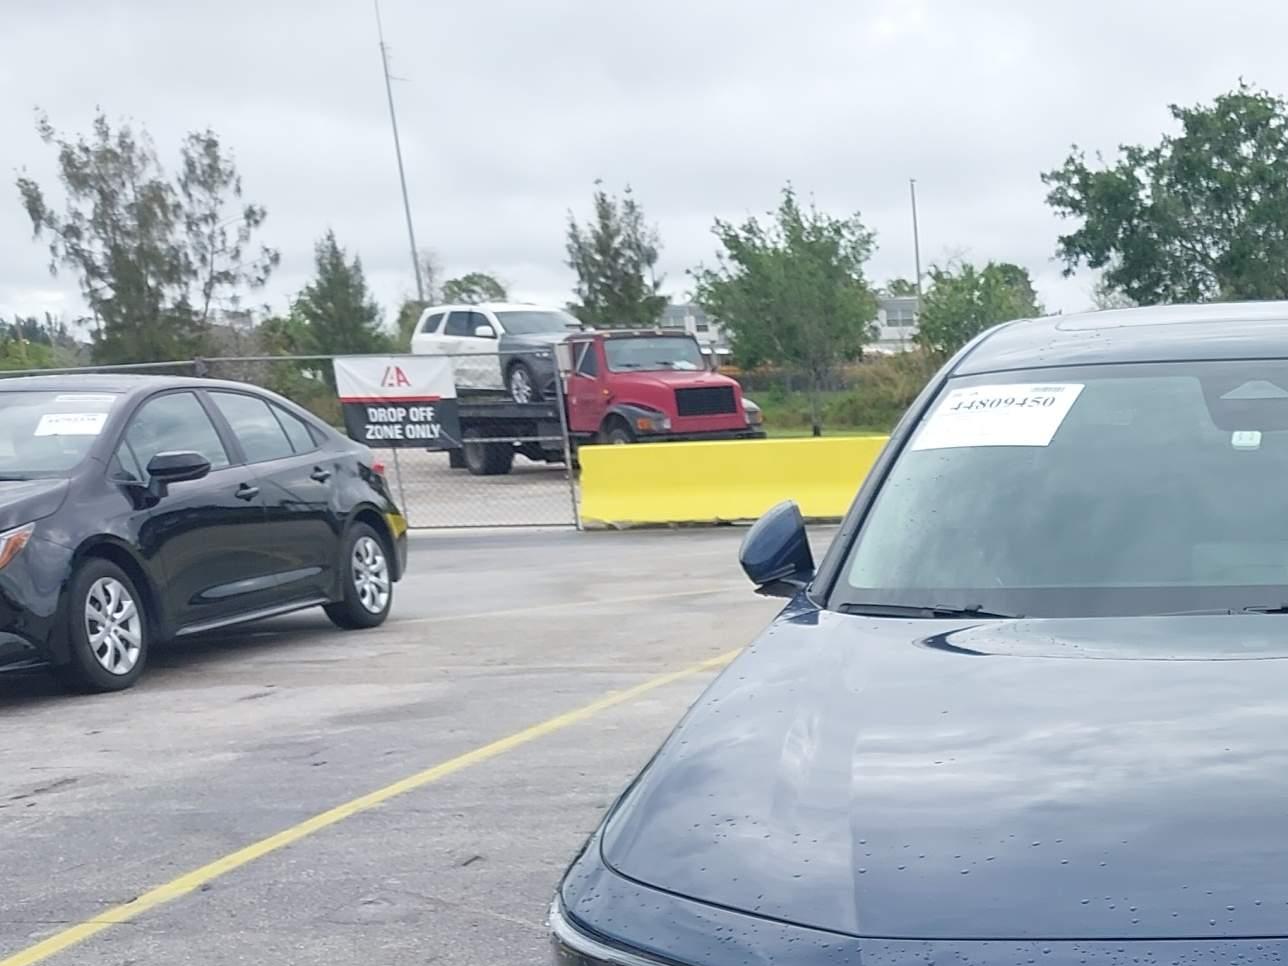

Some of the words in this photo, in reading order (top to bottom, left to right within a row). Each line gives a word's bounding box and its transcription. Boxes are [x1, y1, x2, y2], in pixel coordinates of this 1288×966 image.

[950, 396, 1057, 411] 44809450
[367, 407, 407, 422] DROP
[409, 407, 435, 421] OFF
[365, 424, 405, 440] ZONE
[405, 424, 441, 439] ONLY
